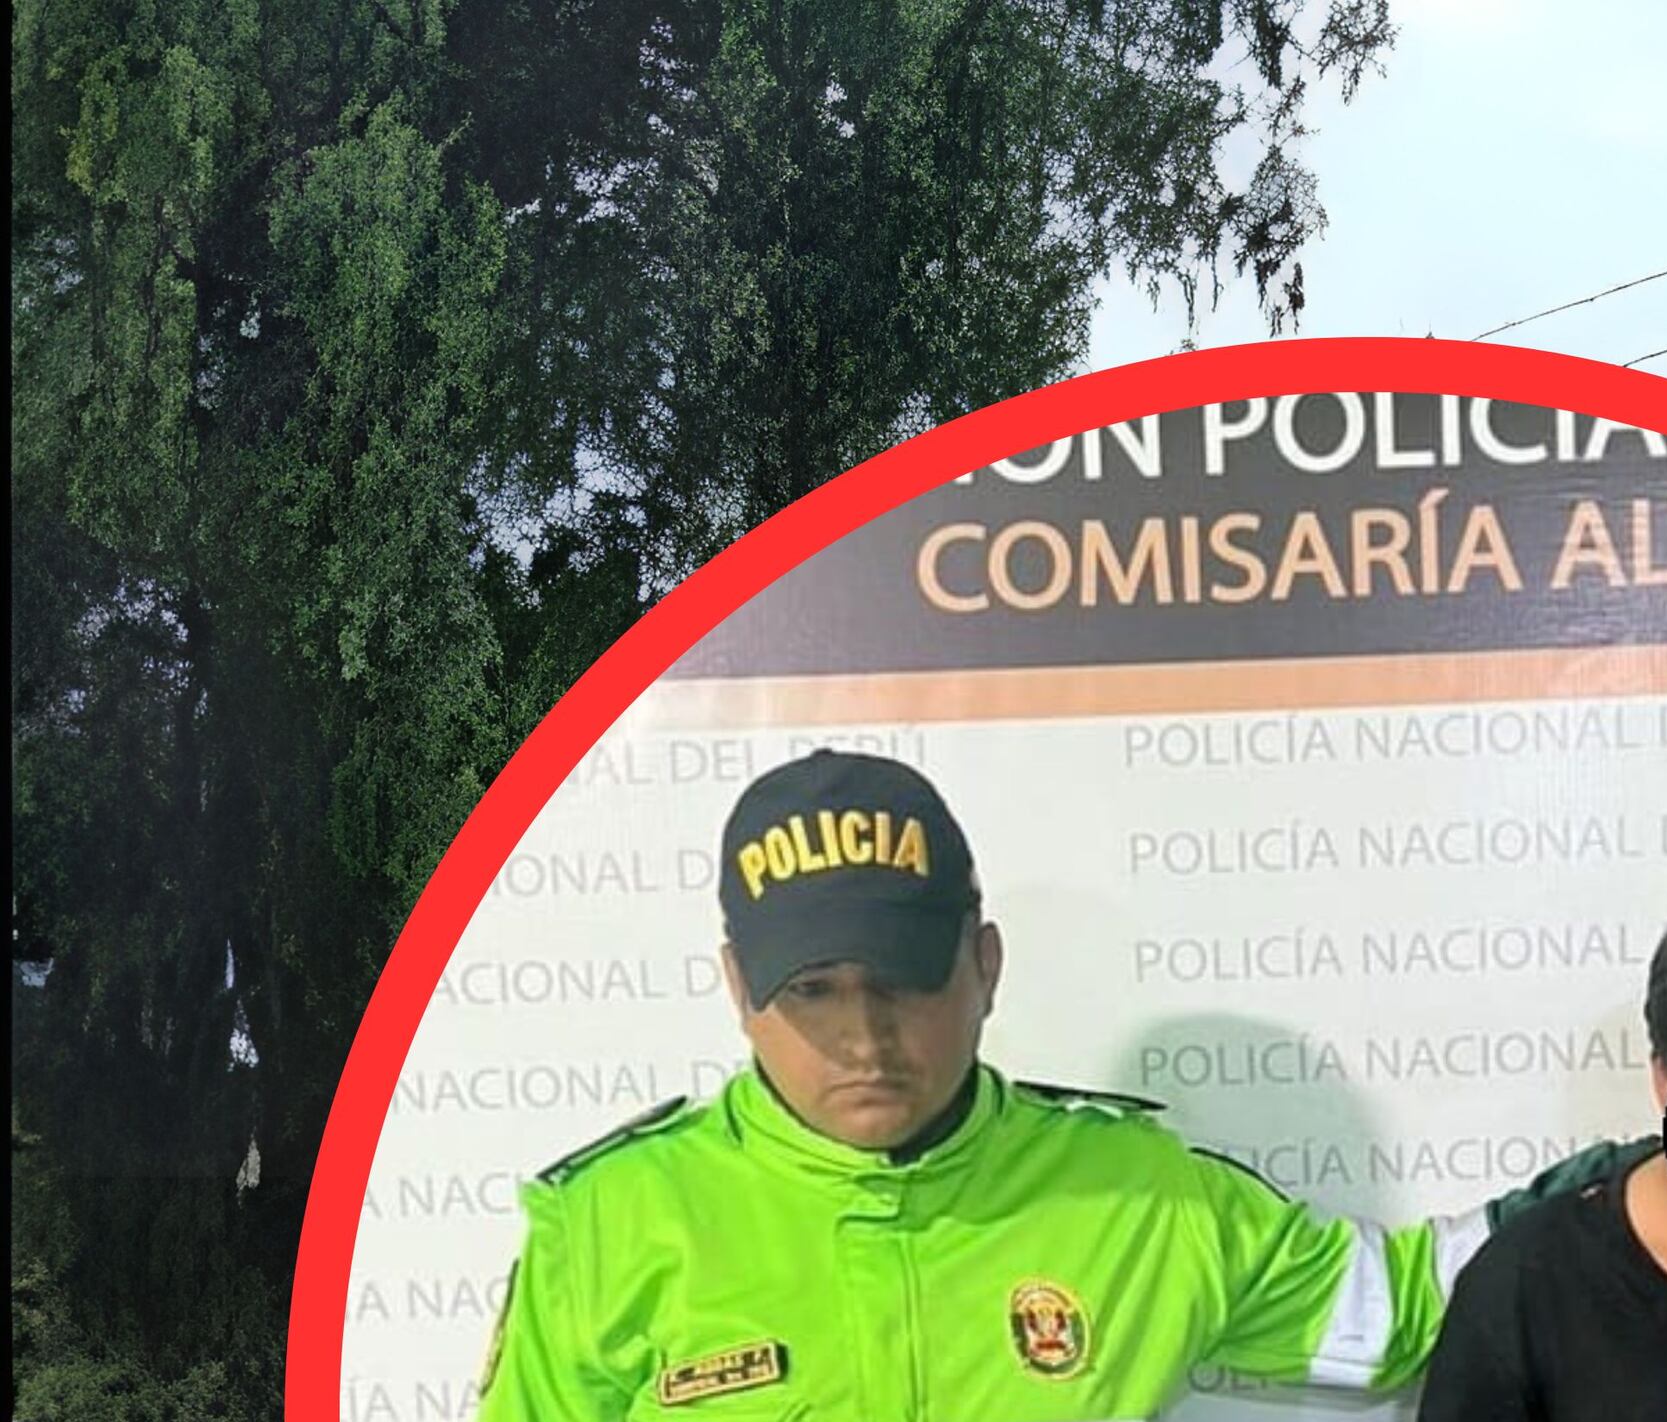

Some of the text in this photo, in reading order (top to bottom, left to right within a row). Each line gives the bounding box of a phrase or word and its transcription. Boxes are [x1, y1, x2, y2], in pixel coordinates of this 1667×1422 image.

[917, 488, 1524, 613] COMISARÍA
[1124, 713, 1338, 768] POLICÍA
[1356, 702, 1642, 762] NACIONAL
[738, 809, 930, 900] POLICIA
[1130, 818, 1340, 875] POLICÍA
[1360, 814, 1642, 868] NACIONAL
[1136, 923, 1647, 983] POLICÍA NACIONAL
[1140, 1029, 1650, 1087] POLICÍA NACIONAL
